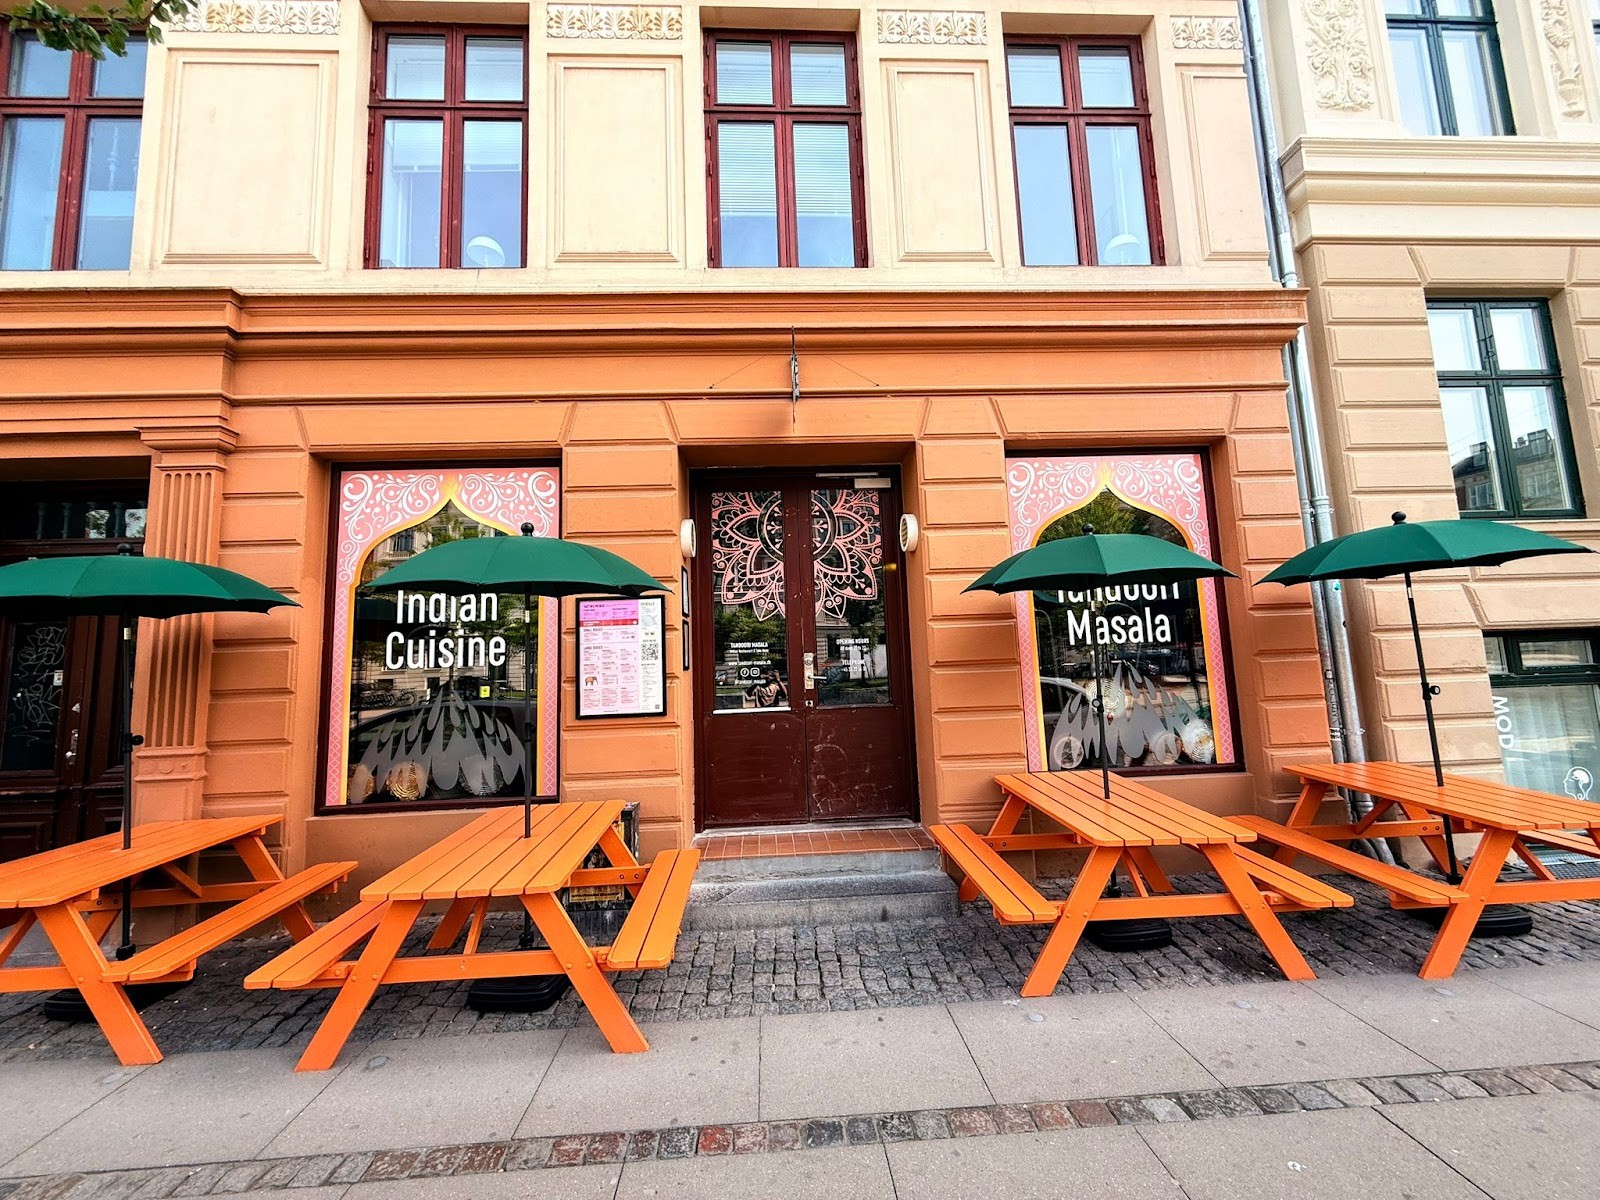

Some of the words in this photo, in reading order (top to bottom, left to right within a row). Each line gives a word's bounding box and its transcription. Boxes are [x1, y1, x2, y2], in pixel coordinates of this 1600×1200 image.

[396, 588, 499, 624] Indian
[1066, 606, 1172, 646] Masala
[385, 629, 507, 670] Cuisine
[1491, 695, 1515, 749] MOD
